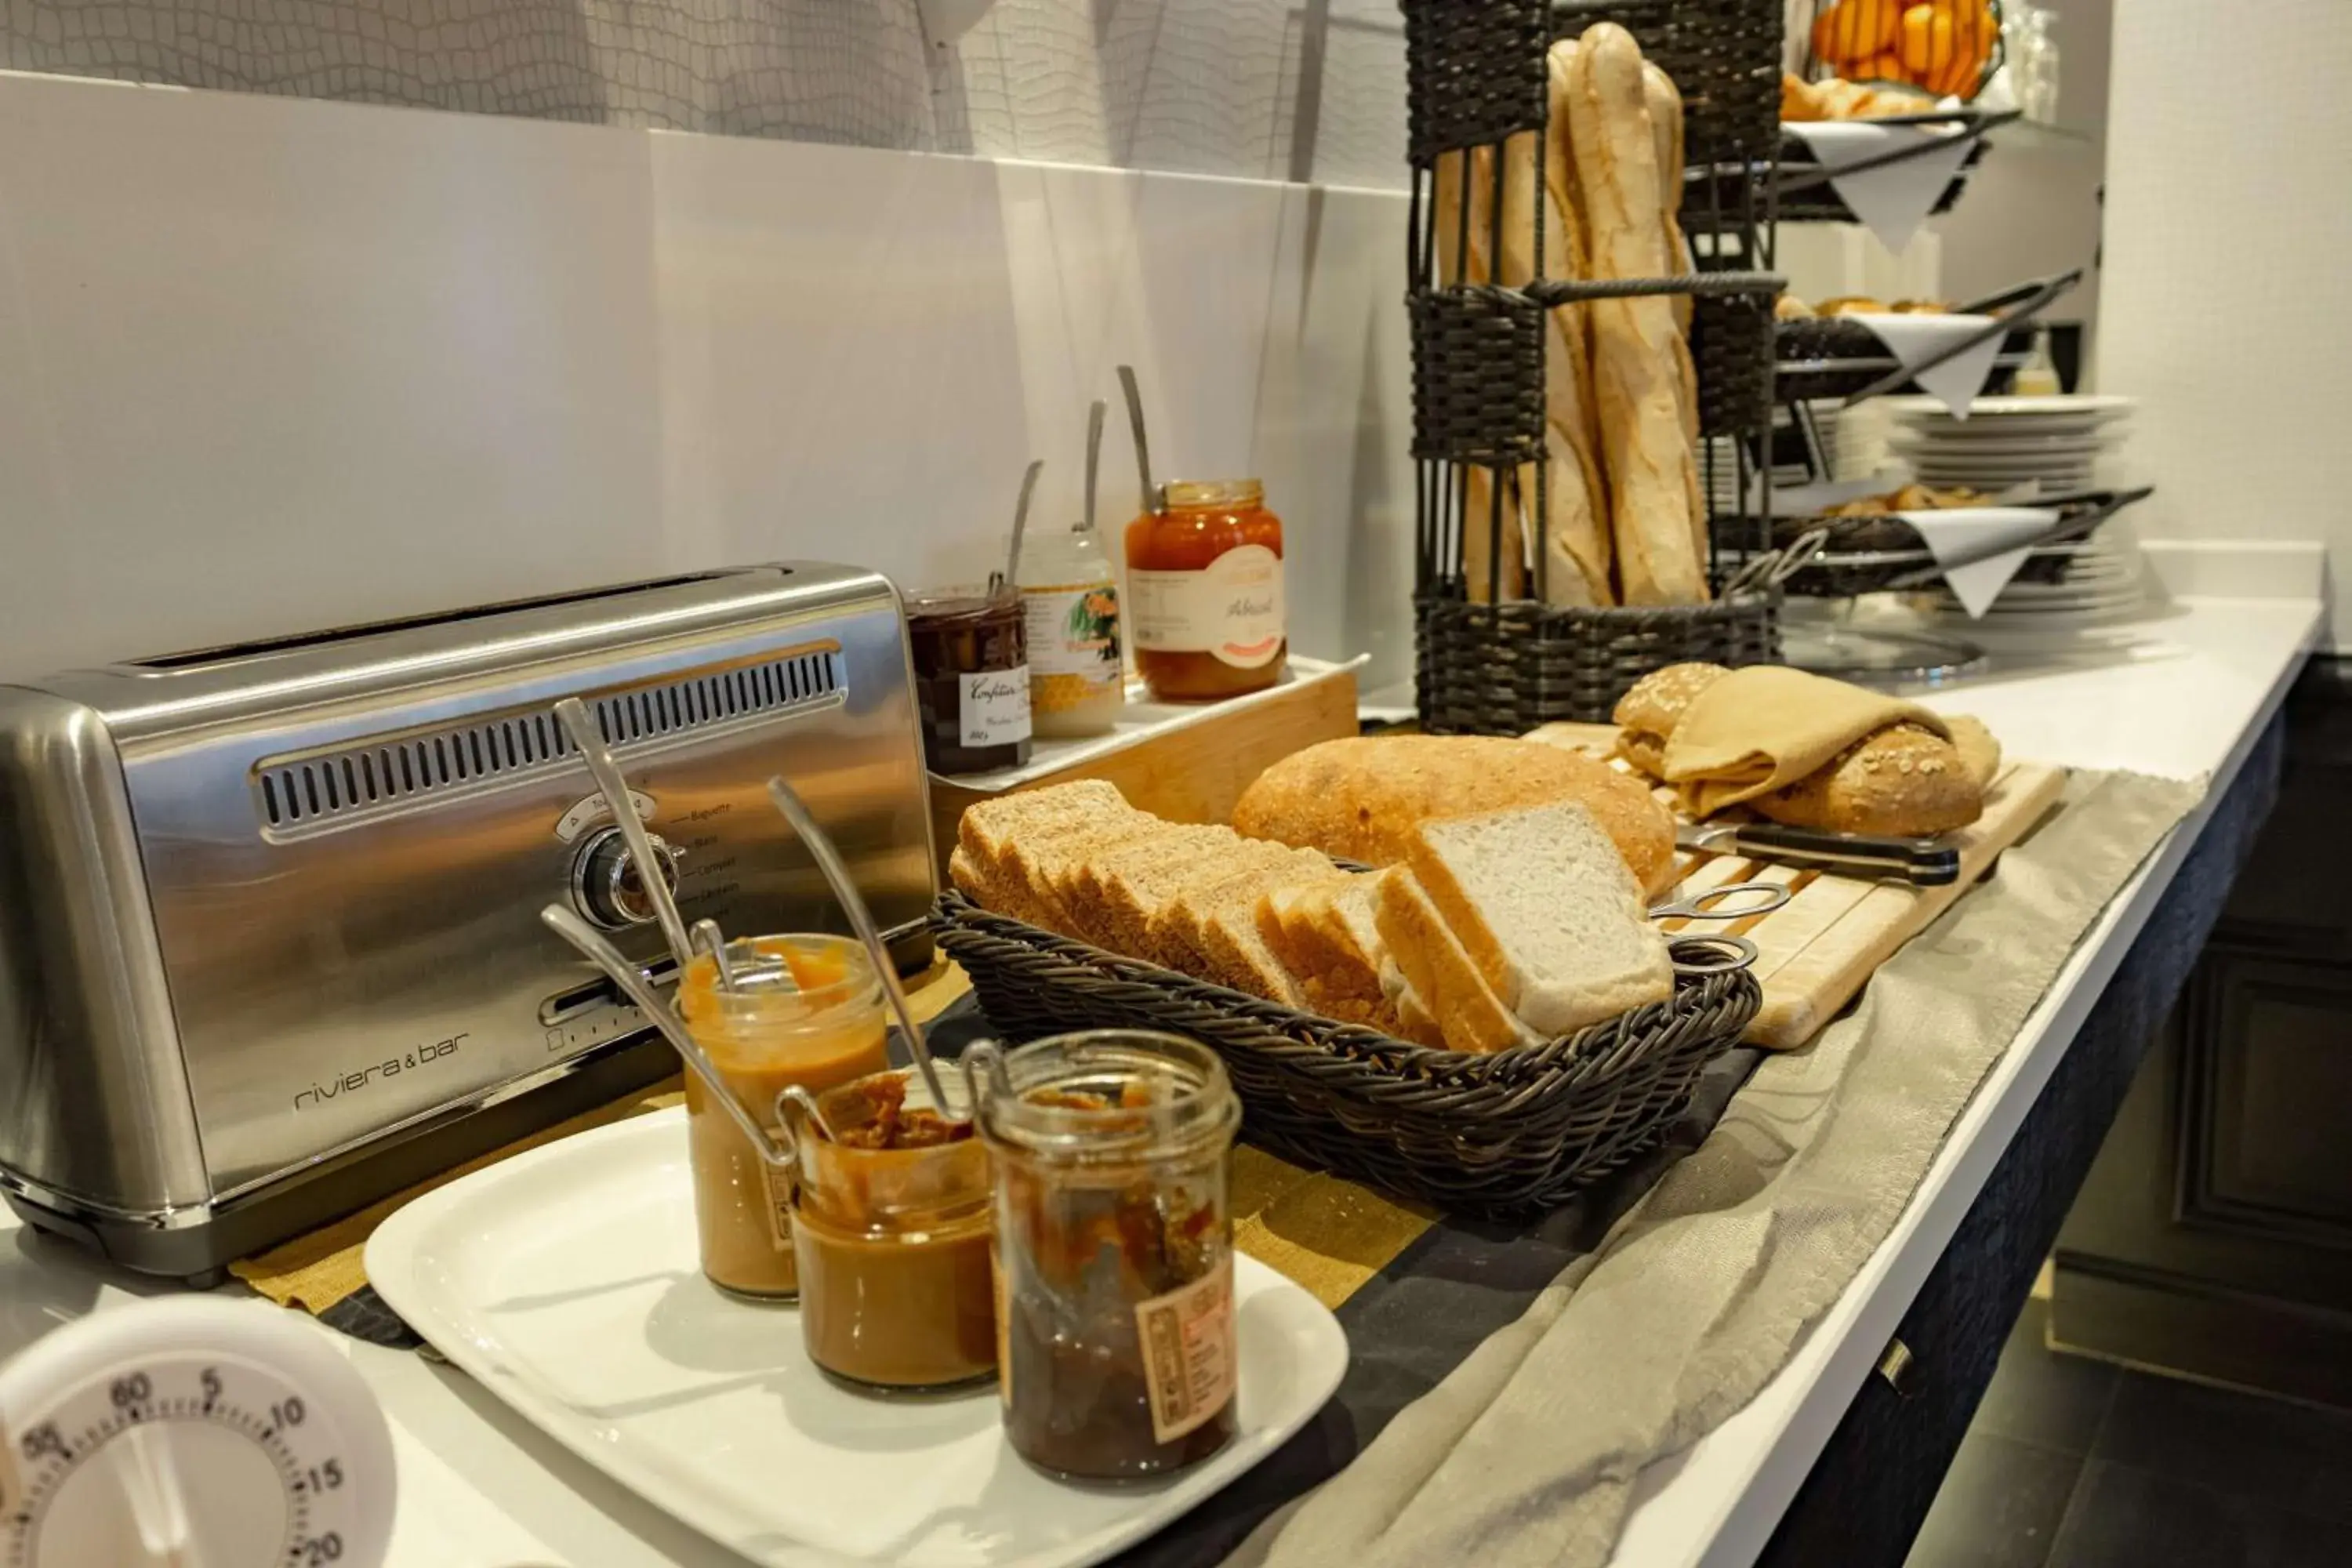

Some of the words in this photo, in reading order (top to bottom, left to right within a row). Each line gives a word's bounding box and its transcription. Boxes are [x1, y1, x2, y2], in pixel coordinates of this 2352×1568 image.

[109, 1371, 151, 1408] 60
[200, 1367, 222, 1399] 5
[269, 1396, 306, 1432] 10
[307, 1457, 343, 1494] 15
[303, 1531, 343, 1566] 20
